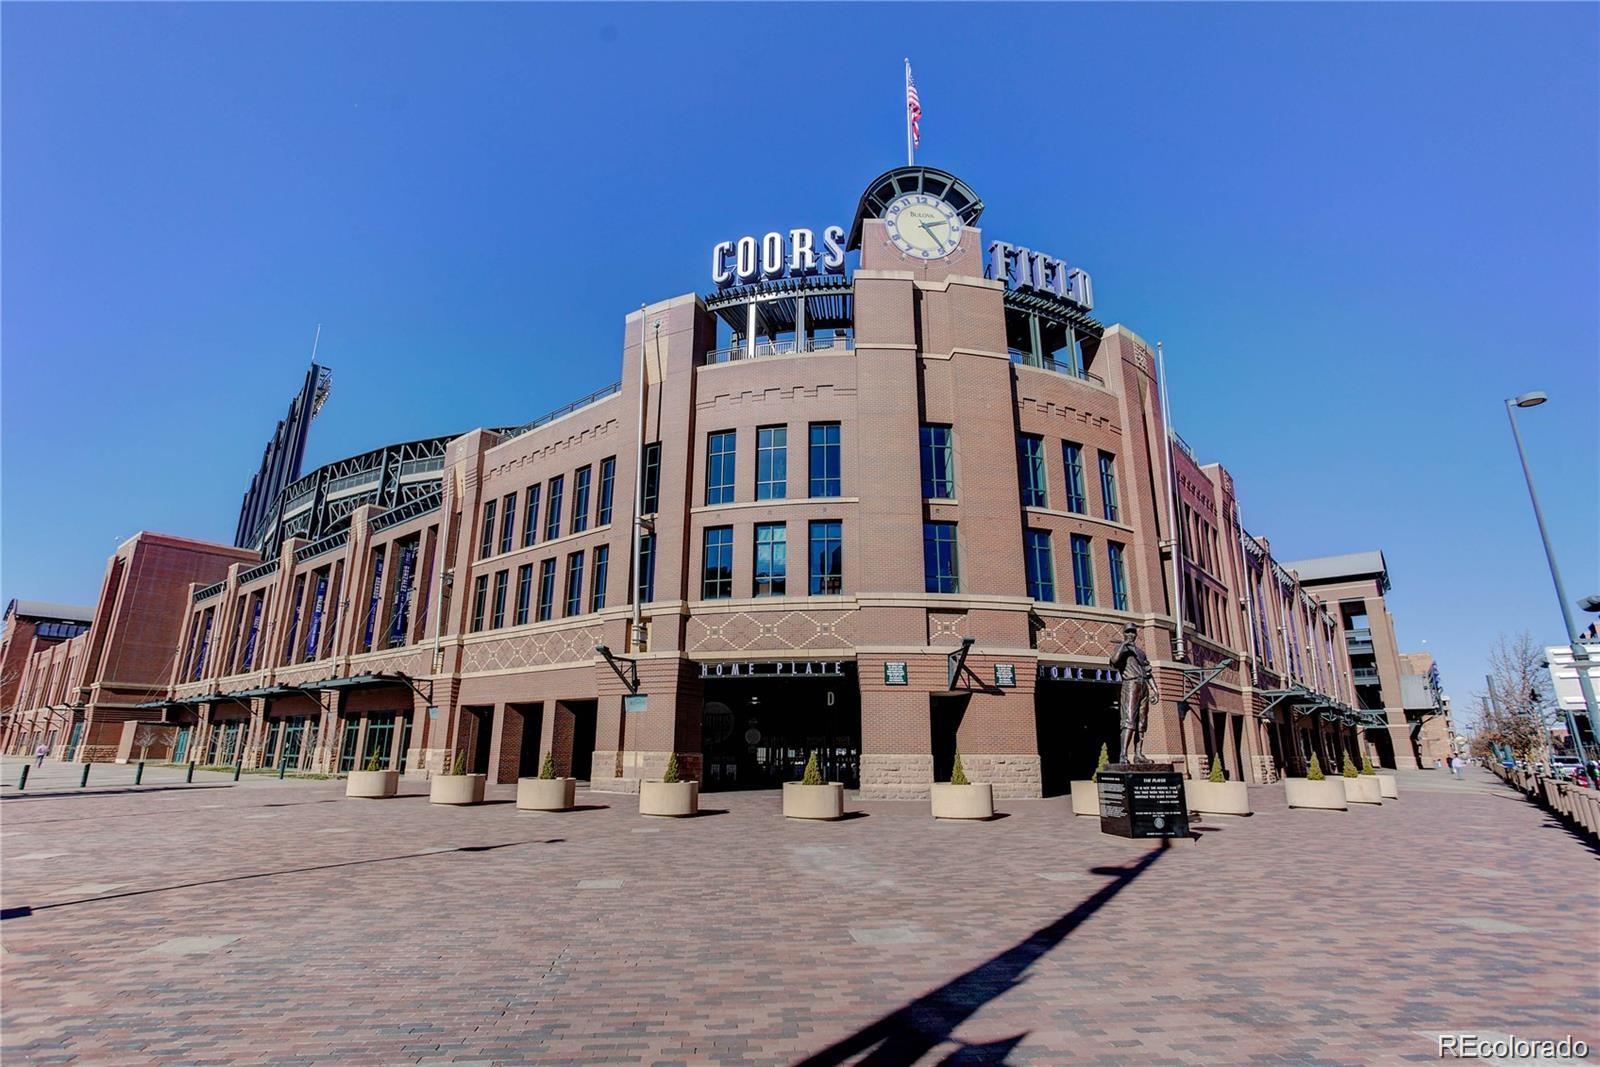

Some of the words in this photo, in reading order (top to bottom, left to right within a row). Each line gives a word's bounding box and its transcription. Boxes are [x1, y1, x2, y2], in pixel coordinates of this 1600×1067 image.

[901, 198, 911, 206] 11
[915, 196, 928, 205] 12
[889, 205, 900, 216] 10
[944, 211, 954, 220] 2
[891, 233, 901, 241] 8
[948, 239, 957, 247] 4
[937, 247, 945, 255] 5
[712, 225, 847, 288] COORS
[989, 239, 1095, 312] FIELD
[701, 662, 755, 676] HOME
[776, 662, 842, 675] PLATE
[1039, 665, 1084, 679] HOME
[1095, 669, 1123, 682] PLA
[827, 691, 835, 706] D
